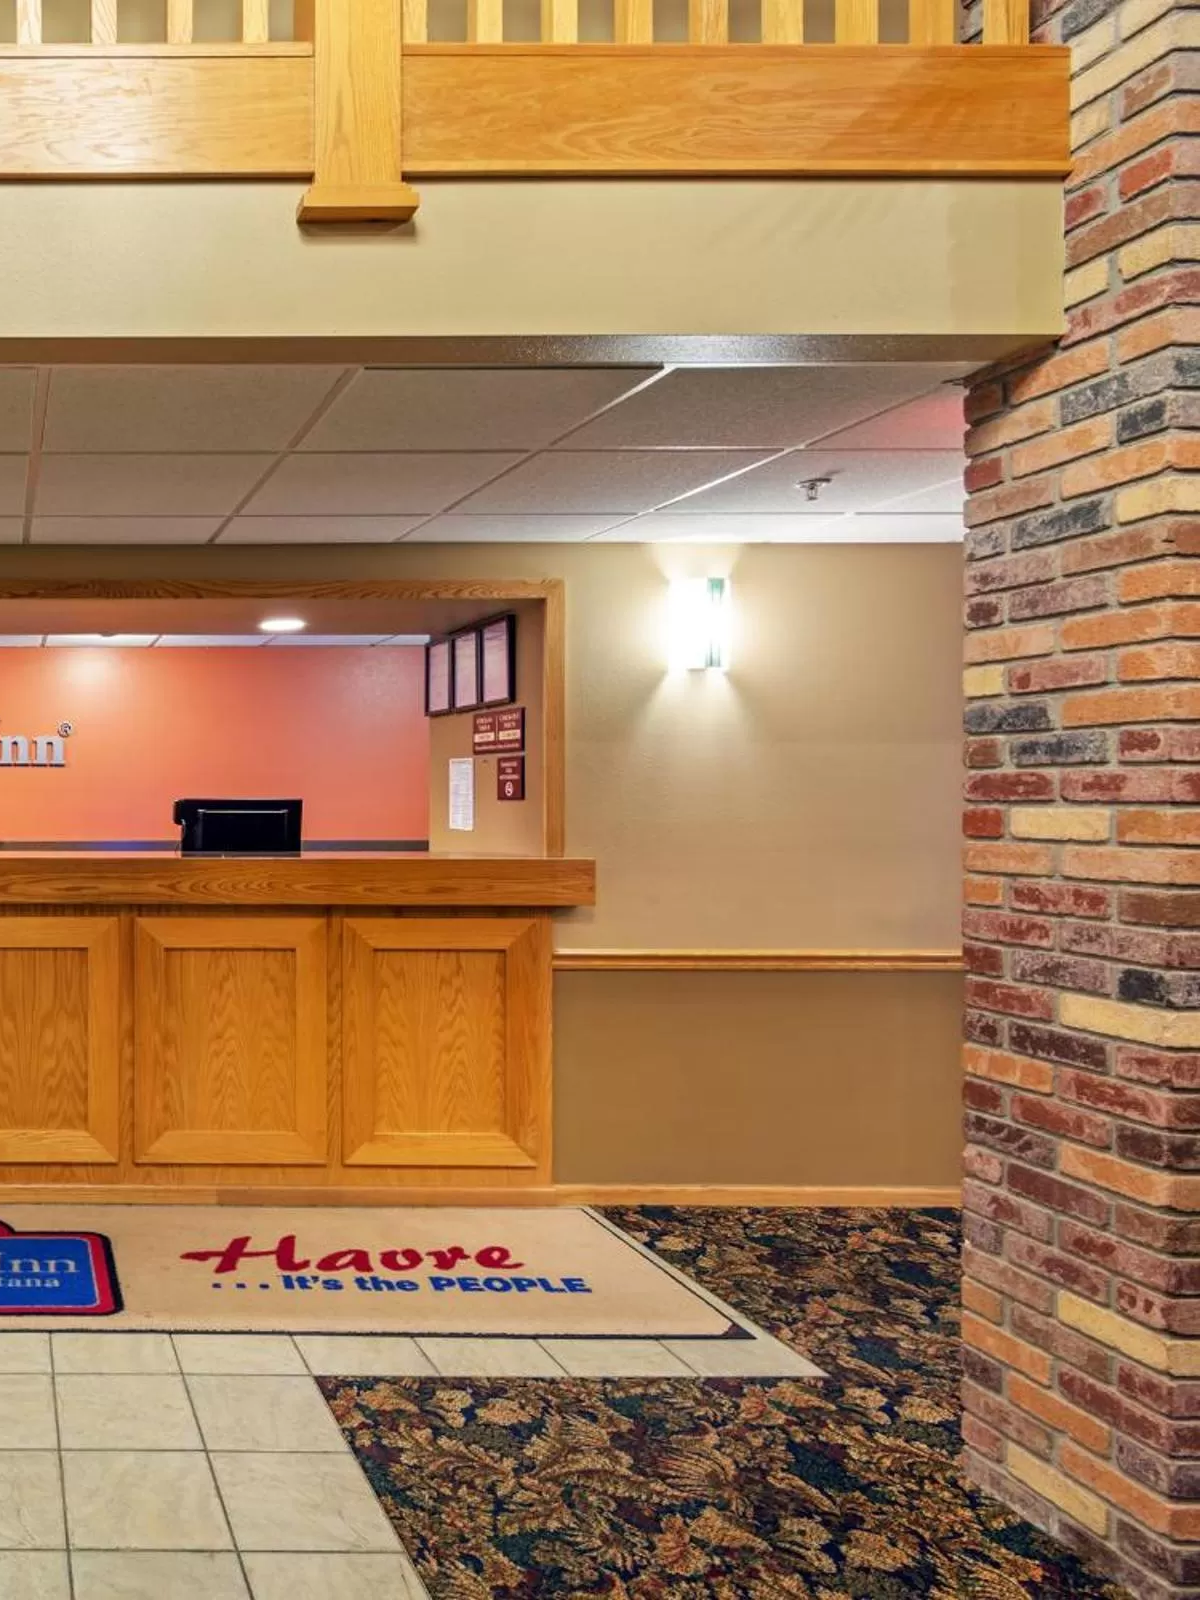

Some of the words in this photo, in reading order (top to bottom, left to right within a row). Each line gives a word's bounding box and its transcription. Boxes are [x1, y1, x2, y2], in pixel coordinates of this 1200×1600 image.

[180, 1235, 525, 1273] Havre
[354, 1275, 419, 1292] the
[427, 1276, 594, 1294] PEOPLE
